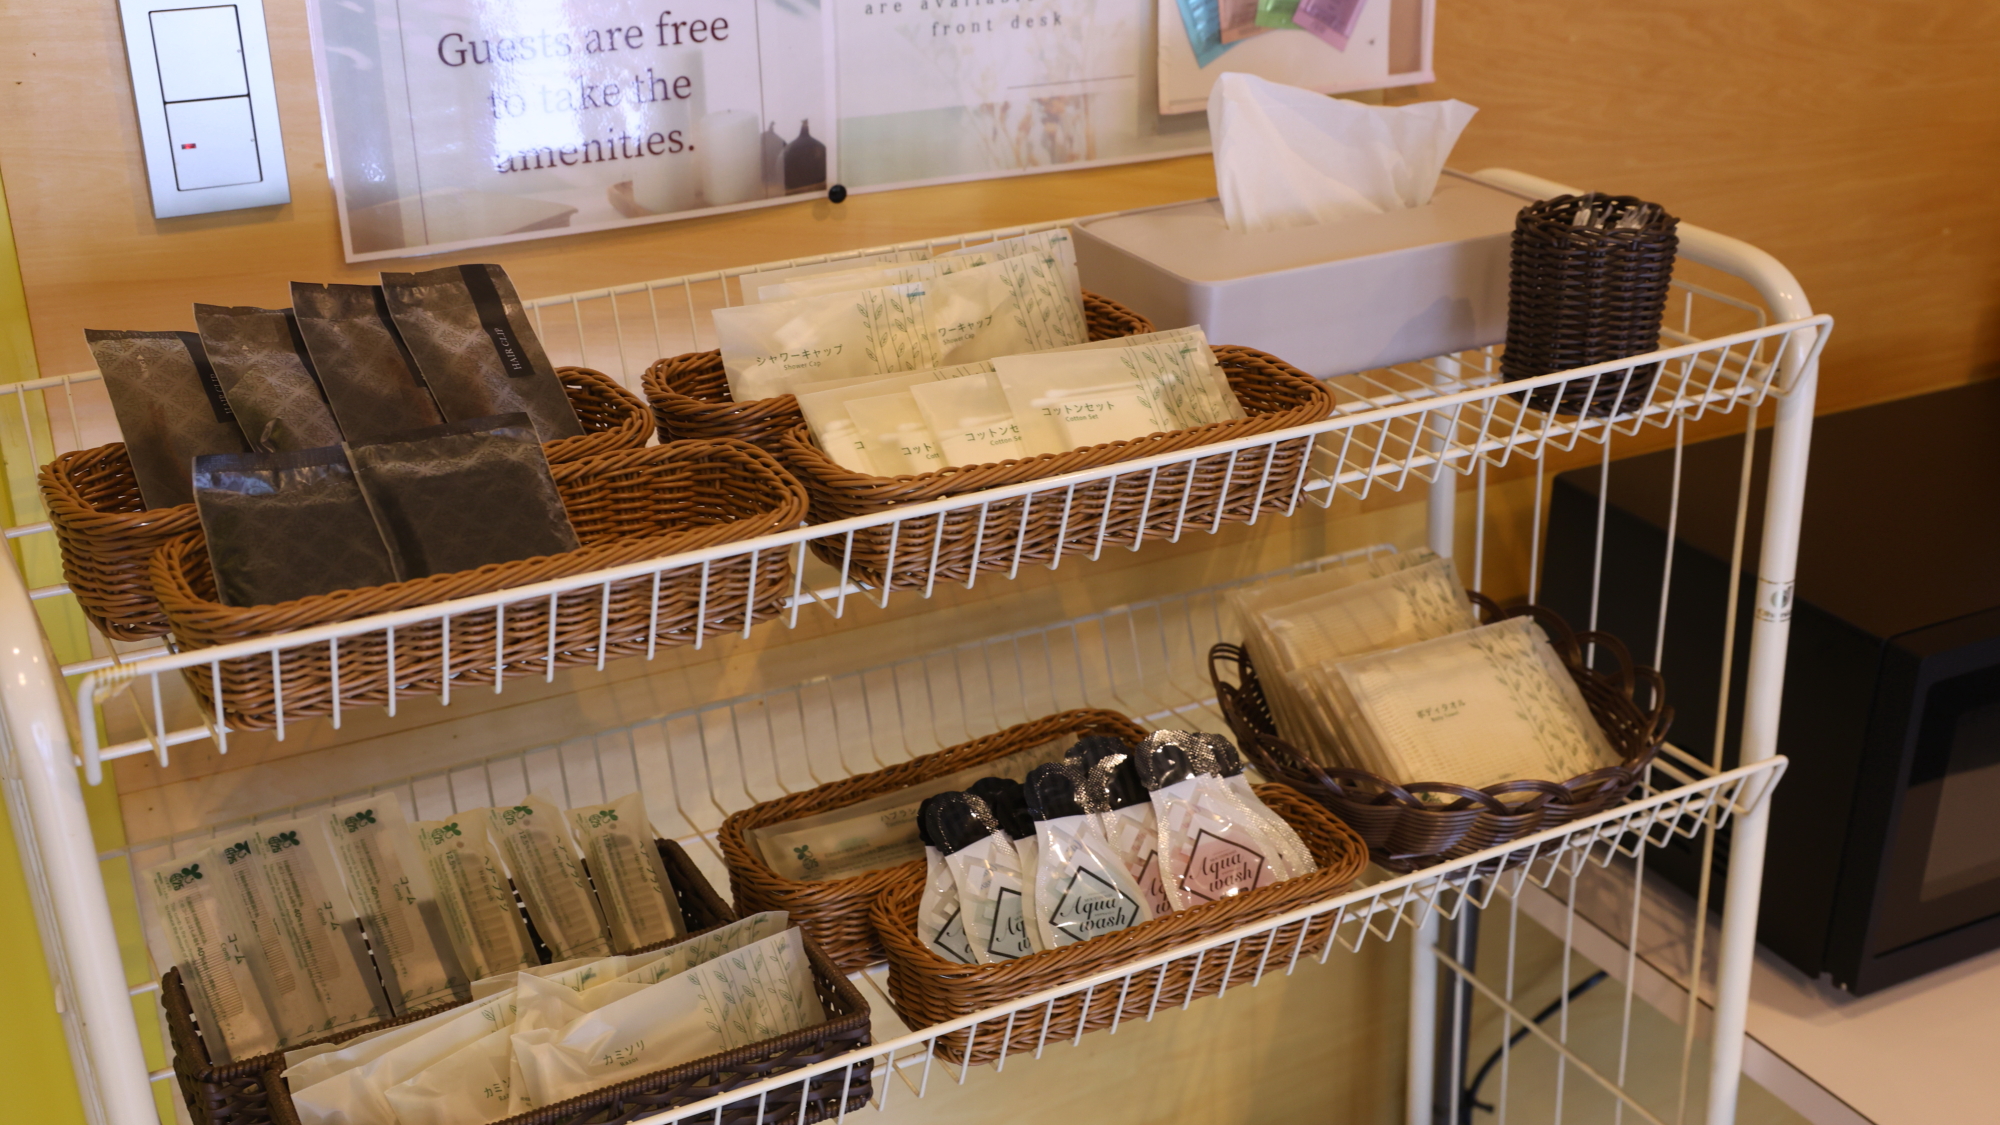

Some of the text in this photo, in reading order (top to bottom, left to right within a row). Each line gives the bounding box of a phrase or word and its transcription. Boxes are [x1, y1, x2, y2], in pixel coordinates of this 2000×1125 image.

[865, 1, 903, 15] are
[932, 11, 1062, 37] front desk
[438, 10, 729, 67] Guests are free
[488, 68, 692, 119] to take the
[496, 128, 695, 174] amenities.
[494, 328, 522, 370] HAIR CLIP
[756, 344, 844, 367] シャワーキャップ
[783, 360, 821, 371] Shower Cap
[1042, 400, 1115, 416] コットンセット
[990, 437, 1012, 446] Cotton
[503, 812, 518, 827] 25
[431, 832, 445, 846] 25
[1188, 853, 1241, 879] Aqua
[1209, 862, 1252, 892] wash
[391, 882, 404, 902] Comb
[398, 874, 417, 906] コーム
[315, 906, 328, 927] Comb
[321, 899, 341, 932] コーム
[1060, 895, 1117, 920] Aqua
[1079, 906, 1126, 933] wash
[219, 941, 232, 962] Comb
[225, 931, 247, 965] コーム
[602, 1039, 646, 1066] カミソリ
[620, 1056, 639, 1068] Razor
